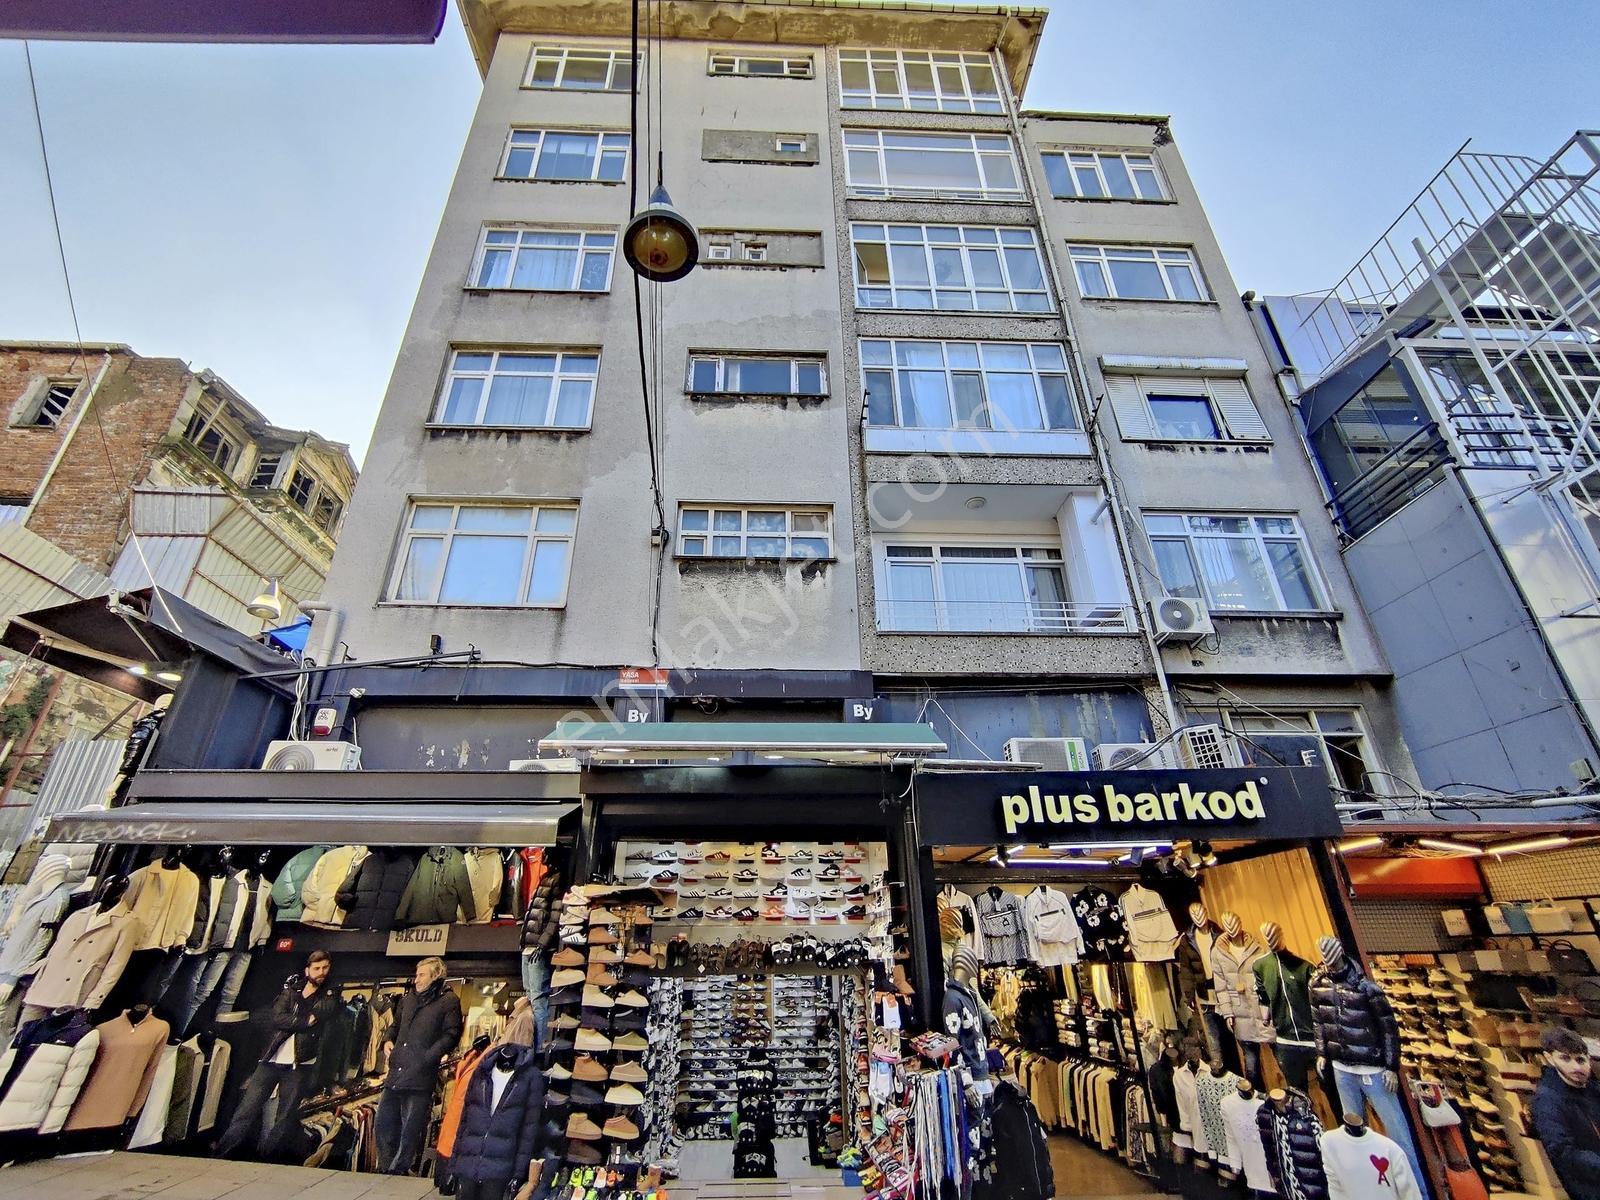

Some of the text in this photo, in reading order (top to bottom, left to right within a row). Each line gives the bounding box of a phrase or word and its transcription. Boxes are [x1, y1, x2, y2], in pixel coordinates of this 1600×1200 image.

[628, 709, 648, 723] By
[853, 704, 873, 720] By
[1001, 781, 1267, 833] plus barkod
